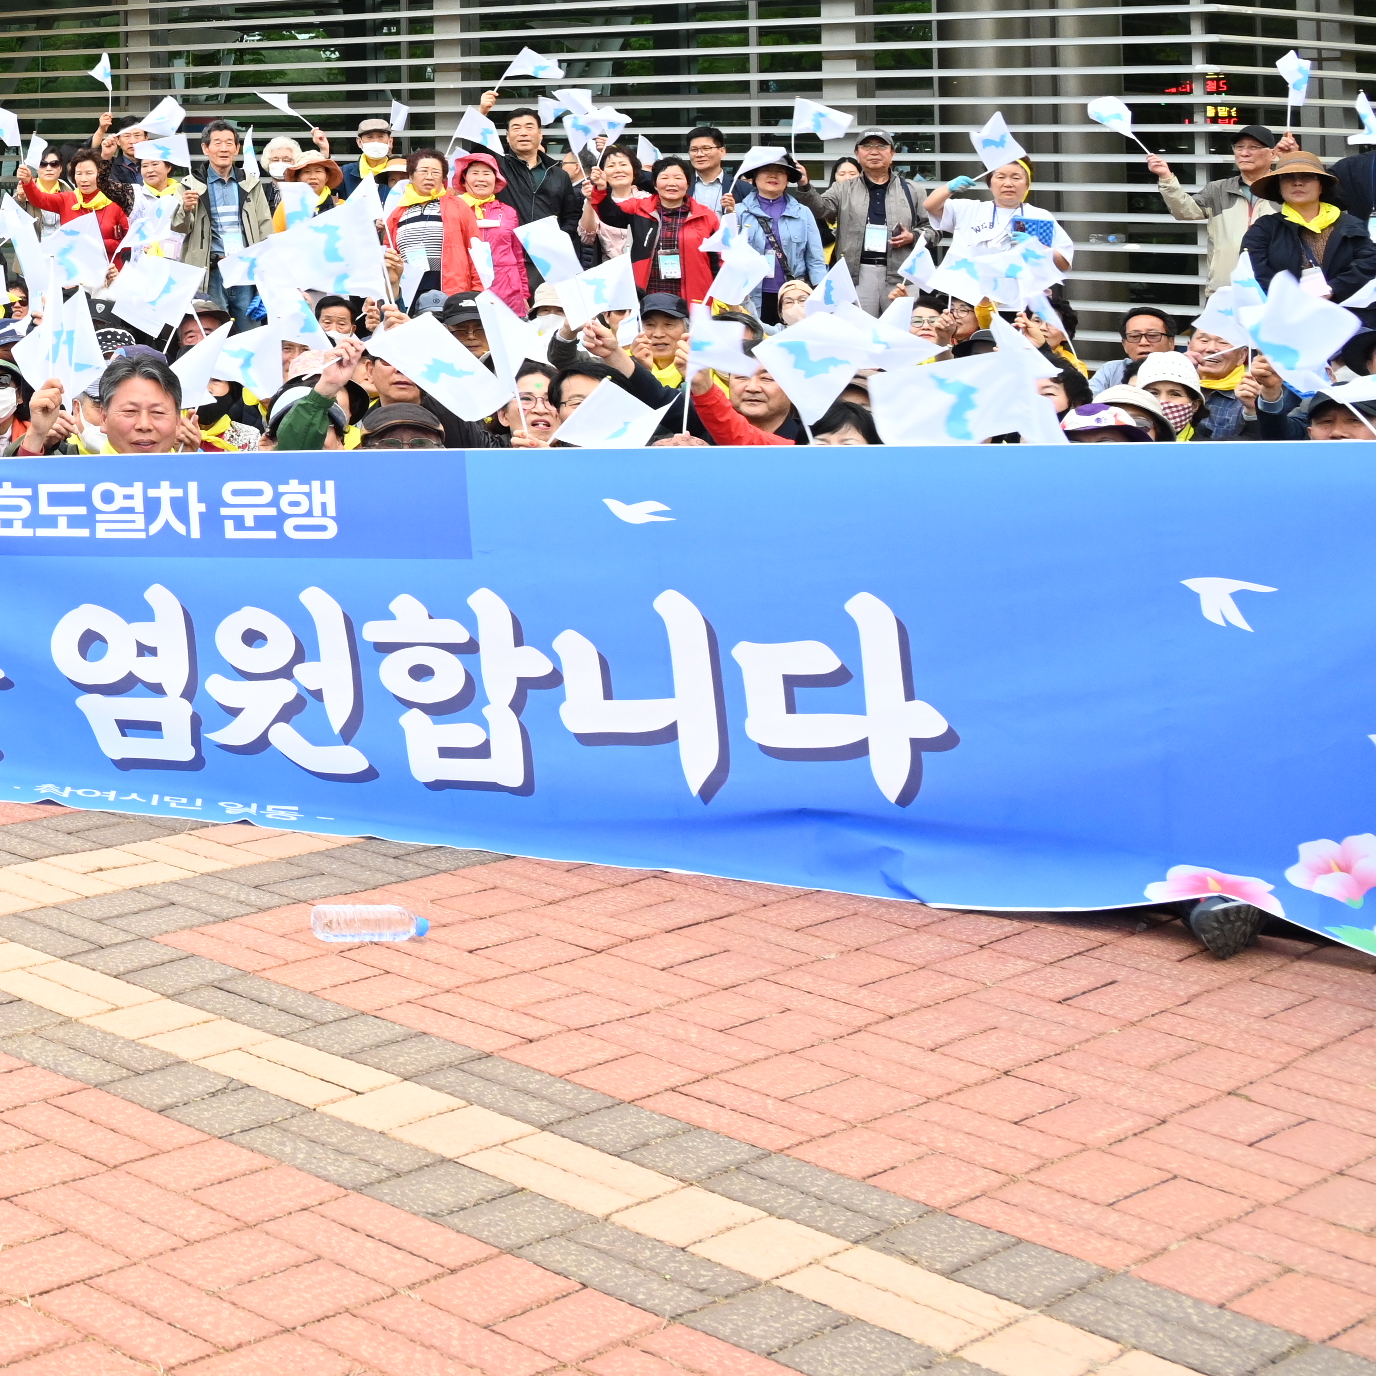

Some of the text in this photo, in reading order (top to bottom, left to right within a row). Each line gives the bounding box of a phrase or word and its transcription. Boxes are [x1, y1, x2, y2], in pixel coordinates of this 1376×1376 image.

[219, 479, 338, 540] 운행
[49, 582, 956, 805] 염원합니다
[34, 782, 203, 811] 참여시민
